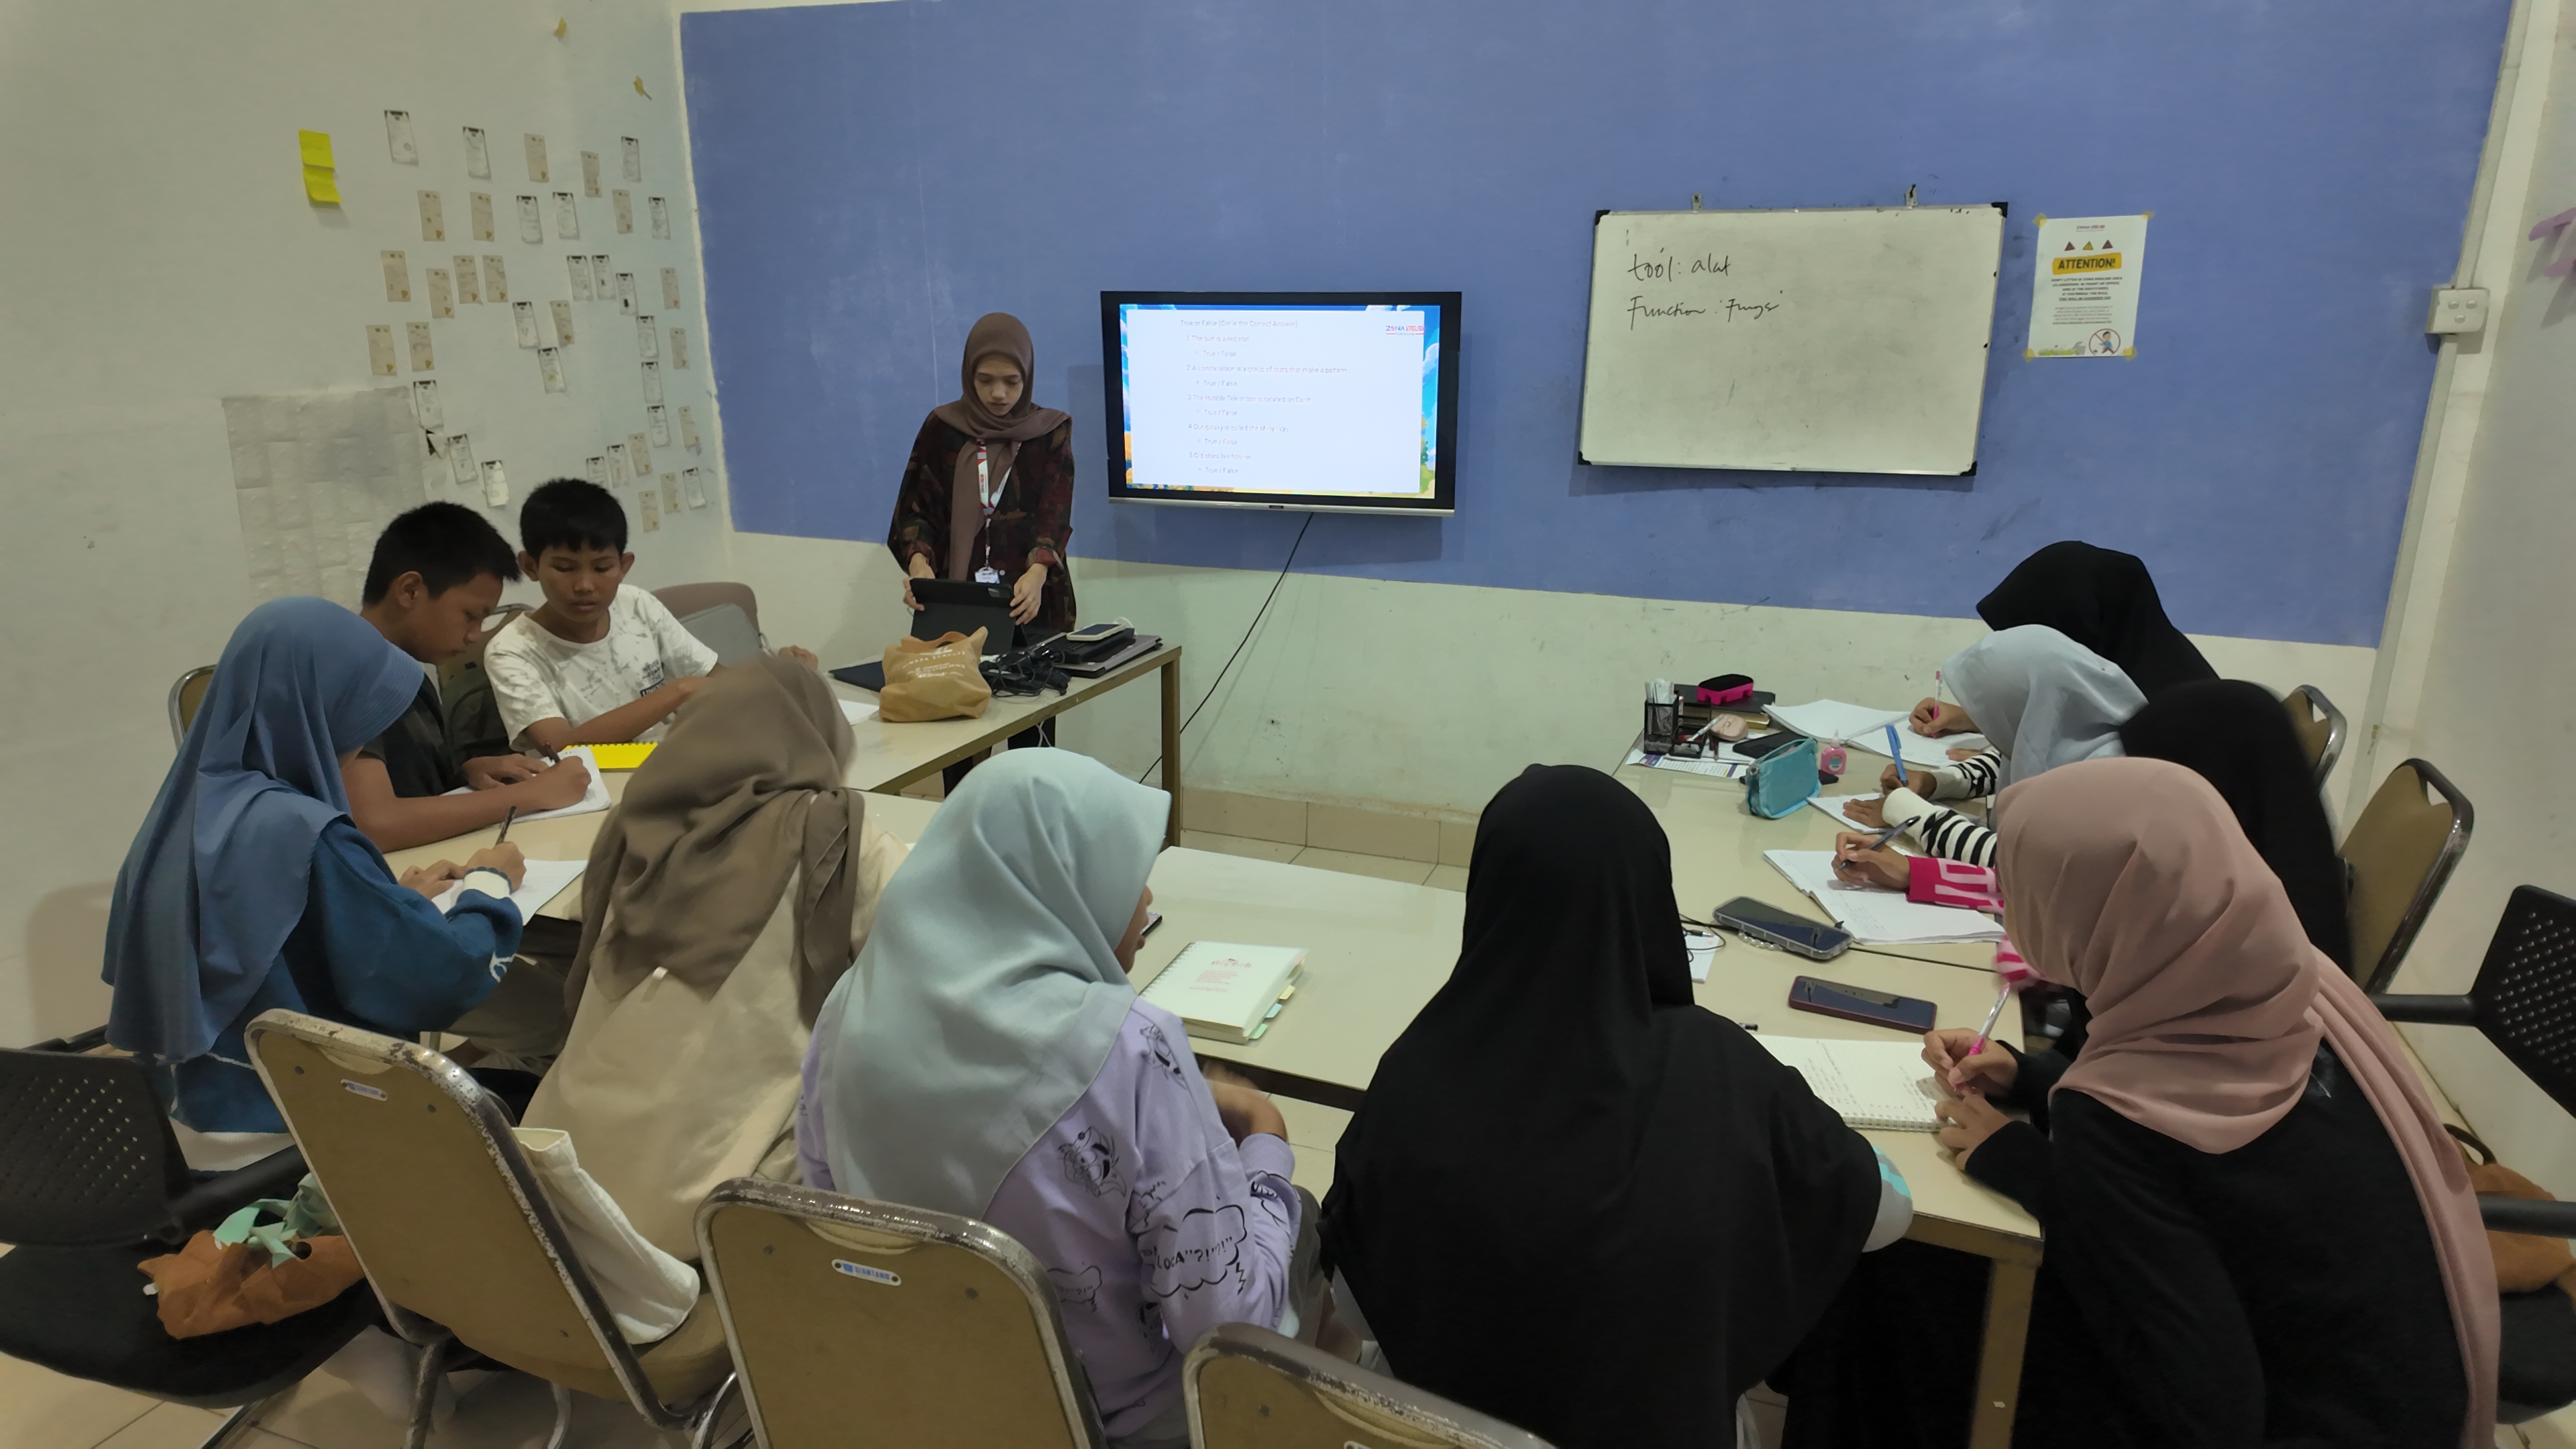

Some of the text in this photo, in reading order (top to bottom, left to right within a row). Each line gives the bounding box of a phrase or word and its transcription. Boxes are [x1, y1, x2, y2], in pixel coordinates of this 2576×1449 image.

[1691, 253, 1731, 276] alat
[2058, 258, 2116, 270] ATTENTION!
[1627, 295, 1706, 331] Function
